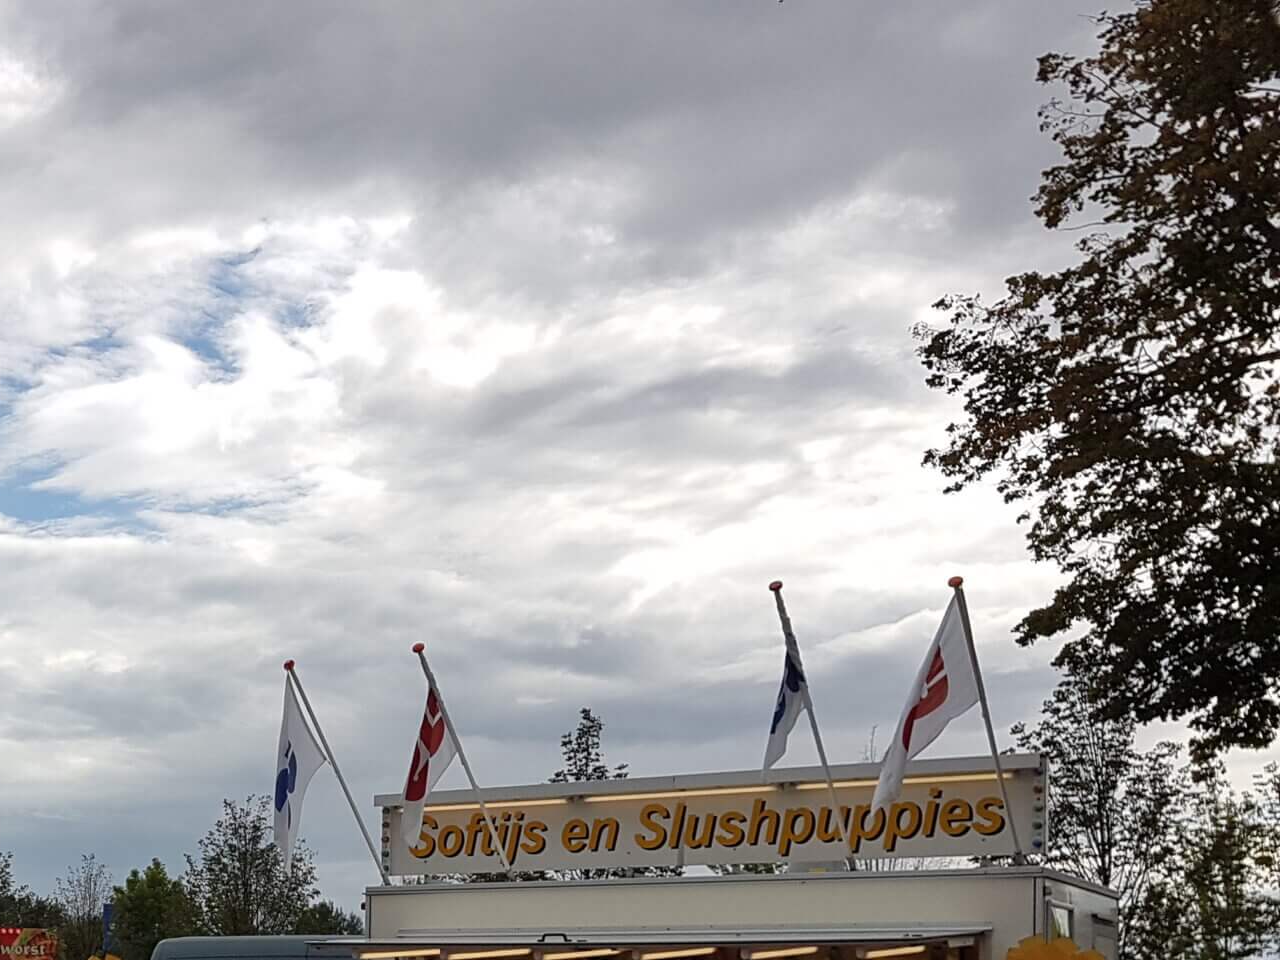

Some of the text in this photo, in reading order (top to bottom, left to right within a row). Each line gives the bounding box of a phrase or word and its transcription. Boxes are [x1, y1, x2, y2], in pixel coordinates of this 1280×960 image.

[408, 786, 1007, 866] Softijs en Slushpuppies
